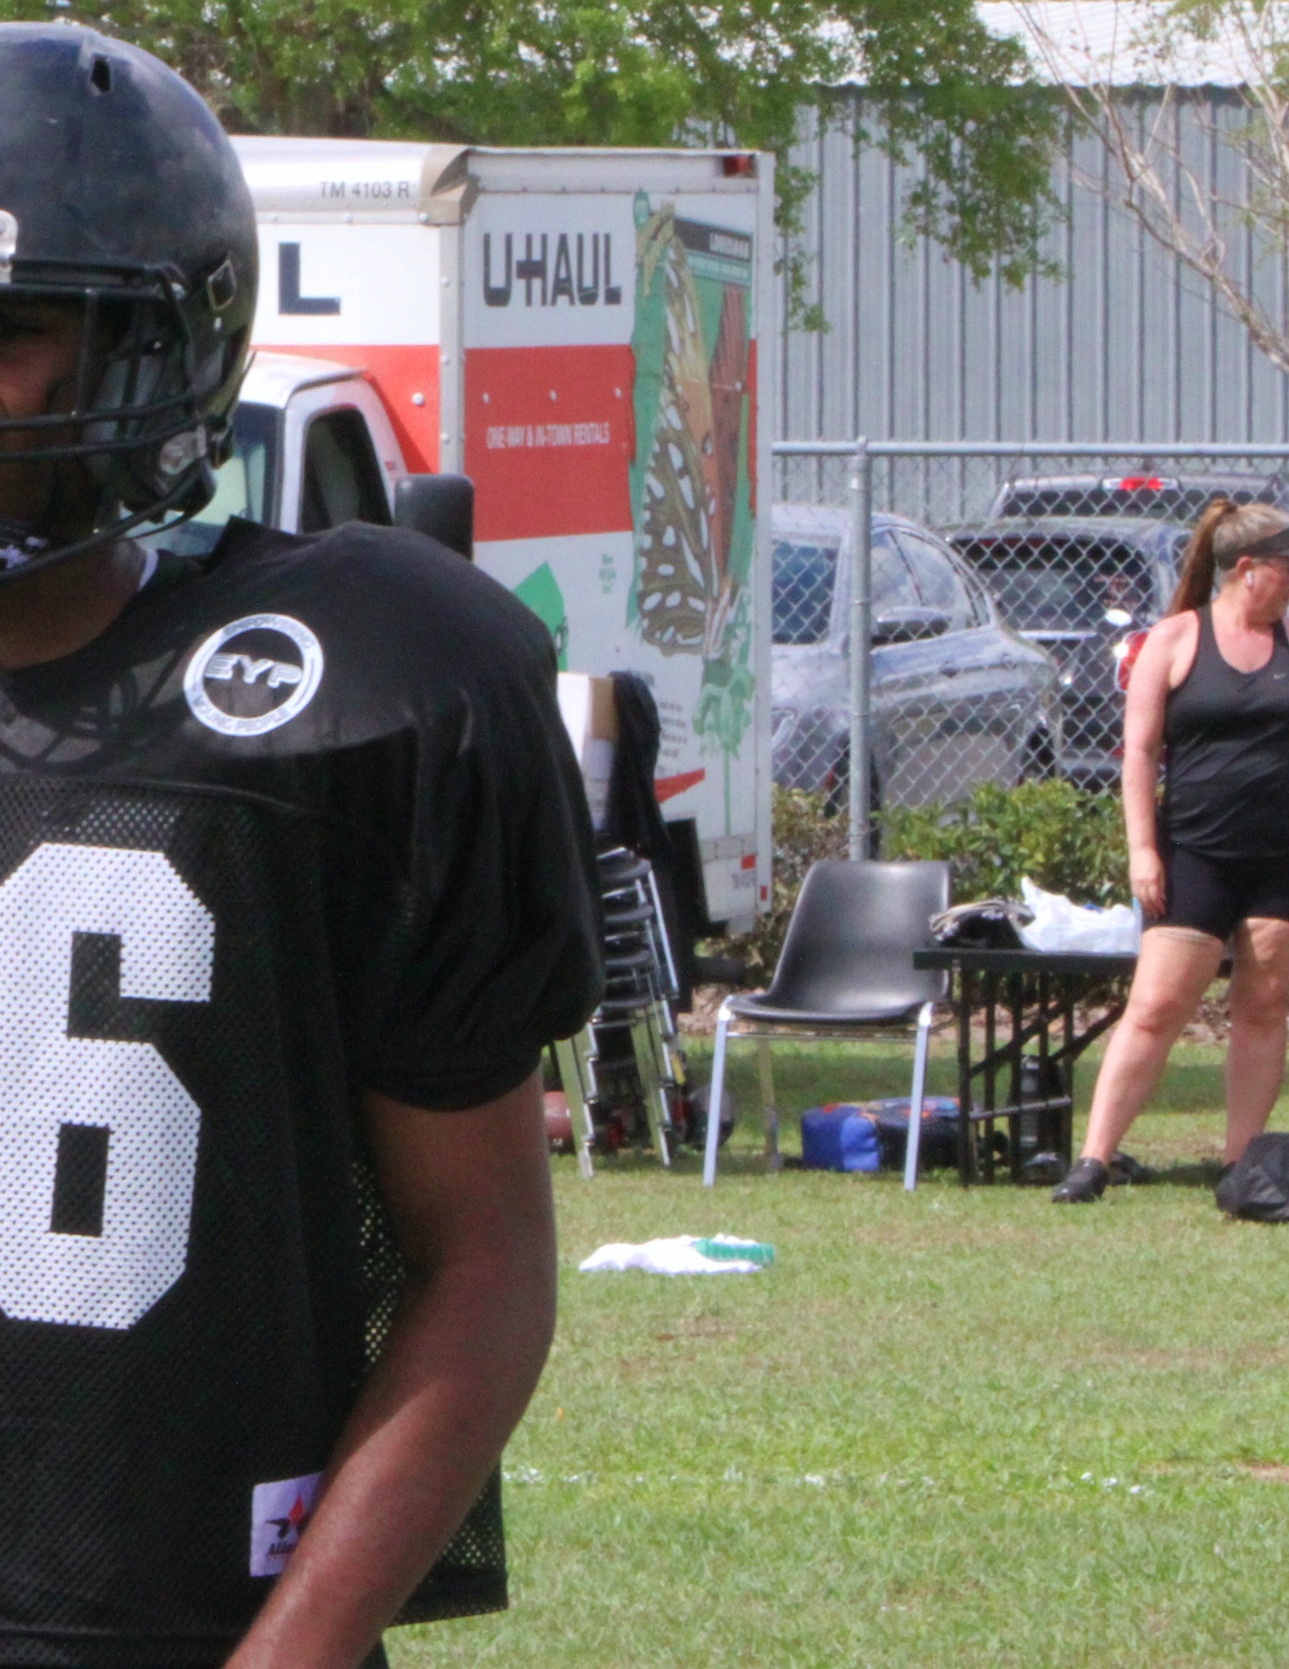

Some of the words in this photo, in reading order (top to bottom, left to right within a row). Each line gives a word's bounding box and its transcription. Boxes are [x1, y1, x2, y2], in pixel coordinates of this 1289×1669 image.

[320, 181, 345, 199] TM
[352, 181, 392, 199] 4103
[398, 181, 410, 199] R
[483, 233, 621, 307] U-HAUL
[204, 653, 303, 688] EYP
